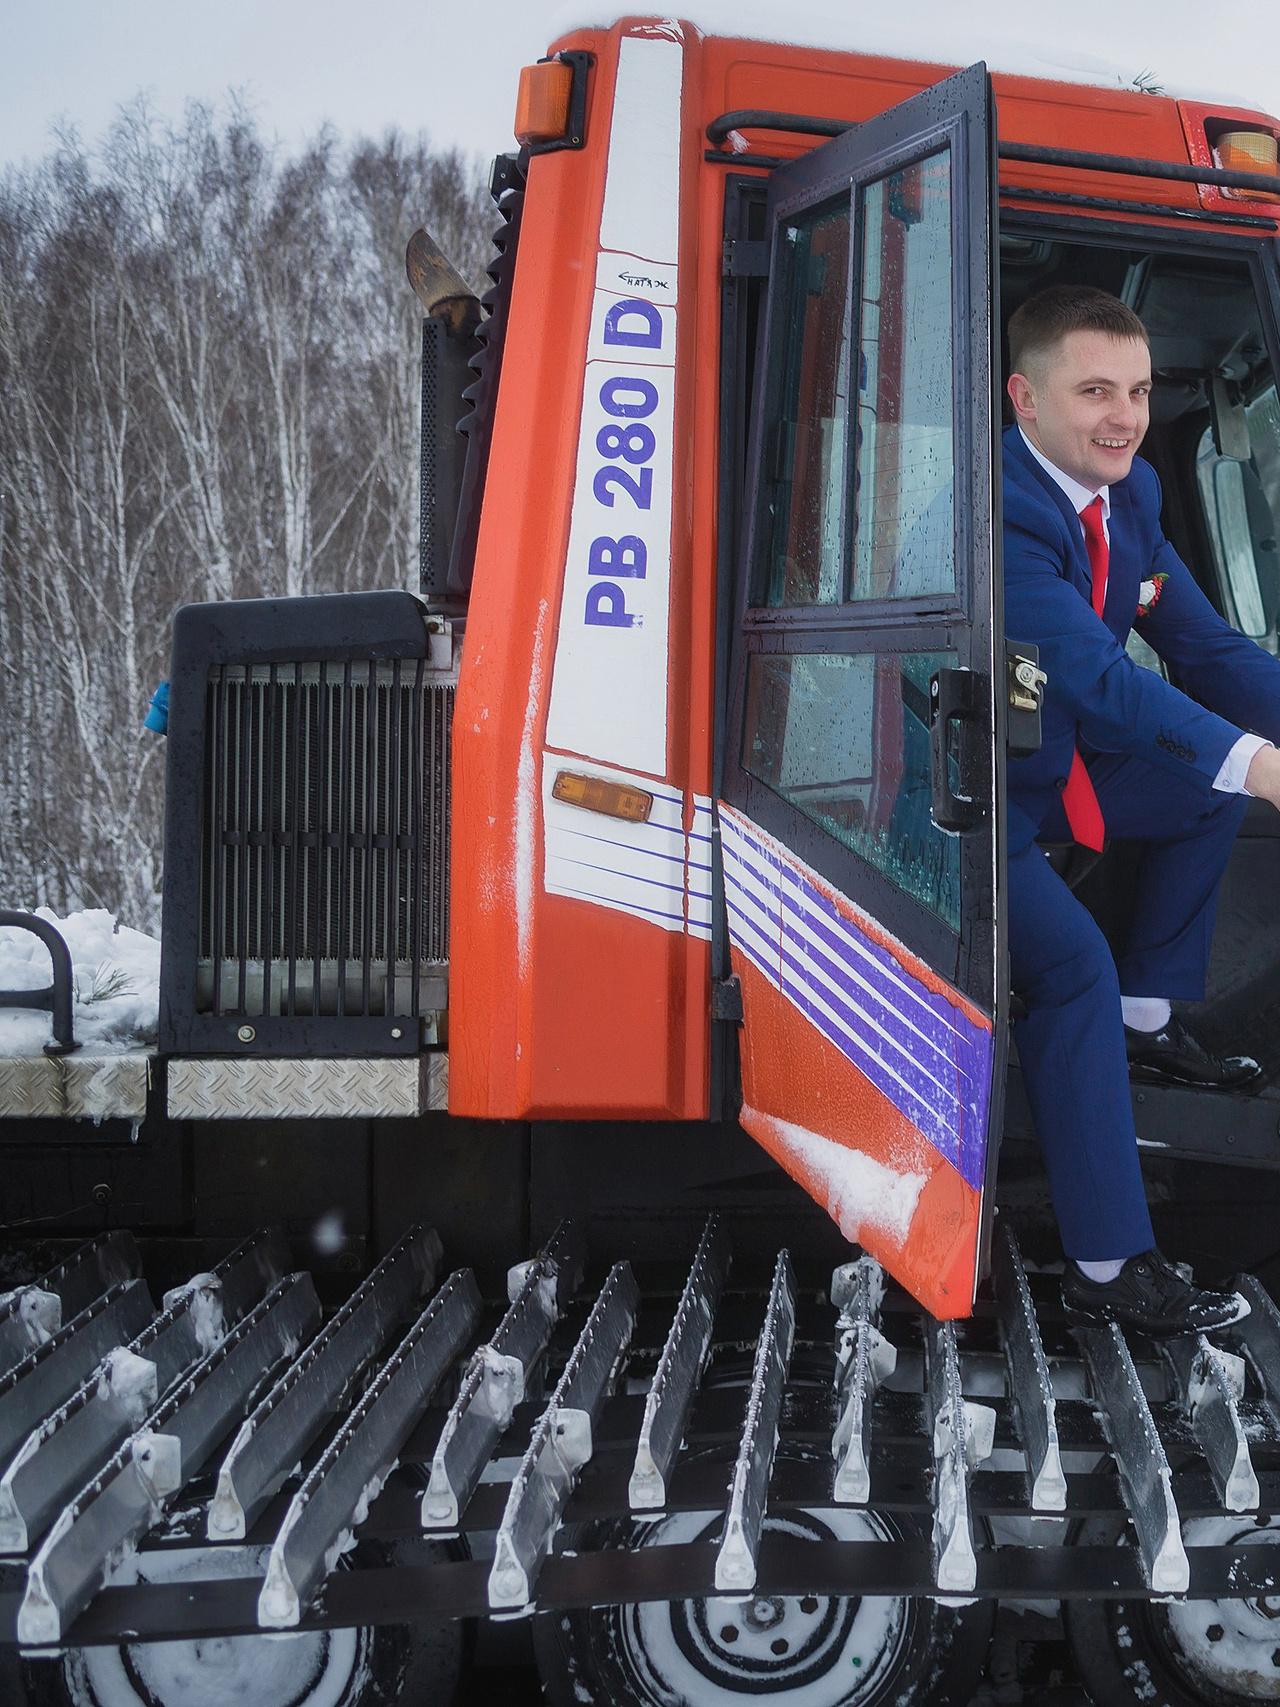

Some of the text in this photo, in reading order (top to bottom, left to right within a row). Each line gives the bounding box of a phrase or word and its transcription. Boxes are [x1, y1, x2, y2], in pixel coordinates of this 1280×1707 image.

[584, 299, 663, 629] PB 280 D
